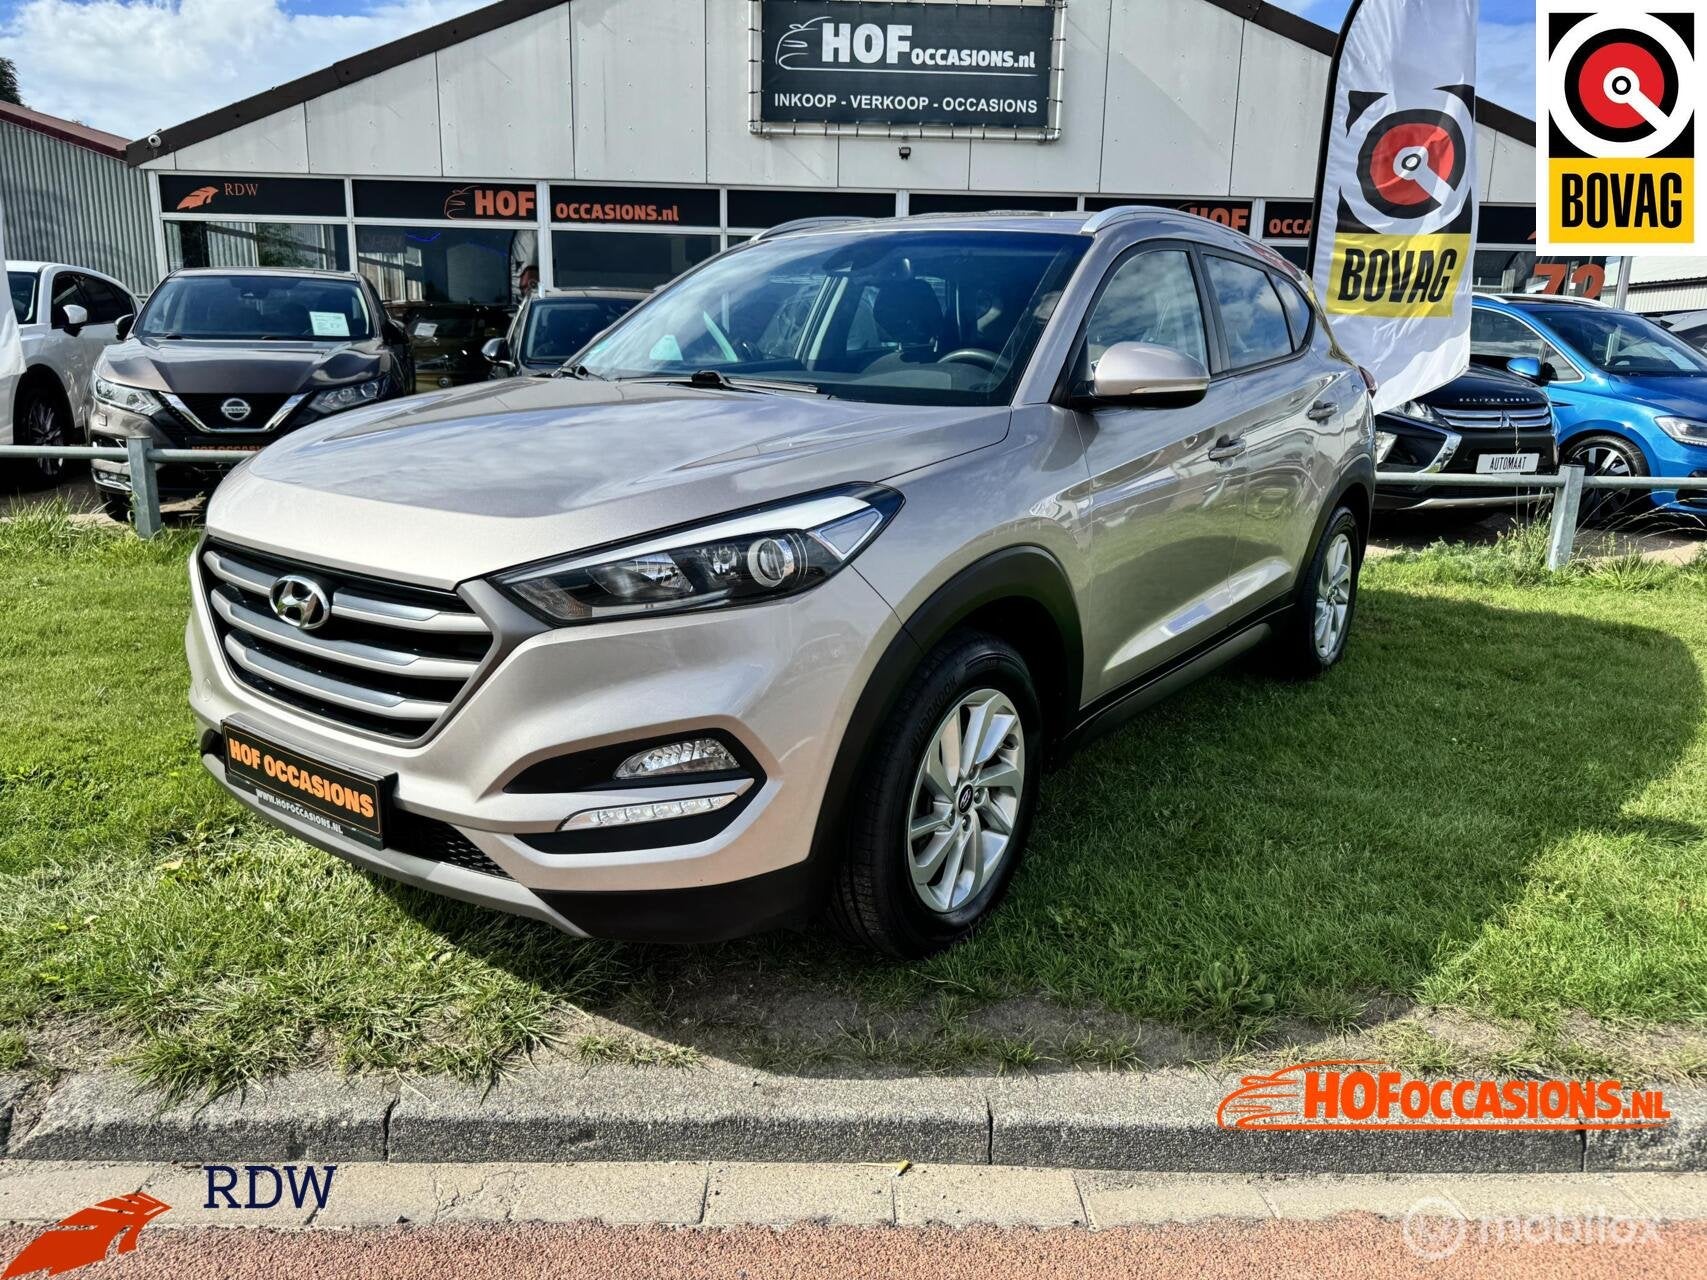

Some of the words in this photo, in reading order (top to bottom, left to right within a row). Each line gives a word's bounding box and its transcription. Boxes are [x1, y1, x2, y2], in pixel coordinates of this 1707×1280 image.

[774, 93, 837, 108] INKOOP
[850, 95, 929, 110] VERKOOP
[942, 96, 1037, 114] OCCASIONS
[223, 183, 259, 196] RDW
[474, 190, 535, 217] HOF
[555, 202, 679, 222] OCCASIONS.nl
[1337, 247, 1458, 305] BOVAG
[1489, 457, 1527, 470] AUTOMAAT
[229, 738, 261, 769] HOF
[264, 754, 375, 818] OCCASIONS
[255, 788, 344, 835] WWW.HOFOCCASIONS.NL
